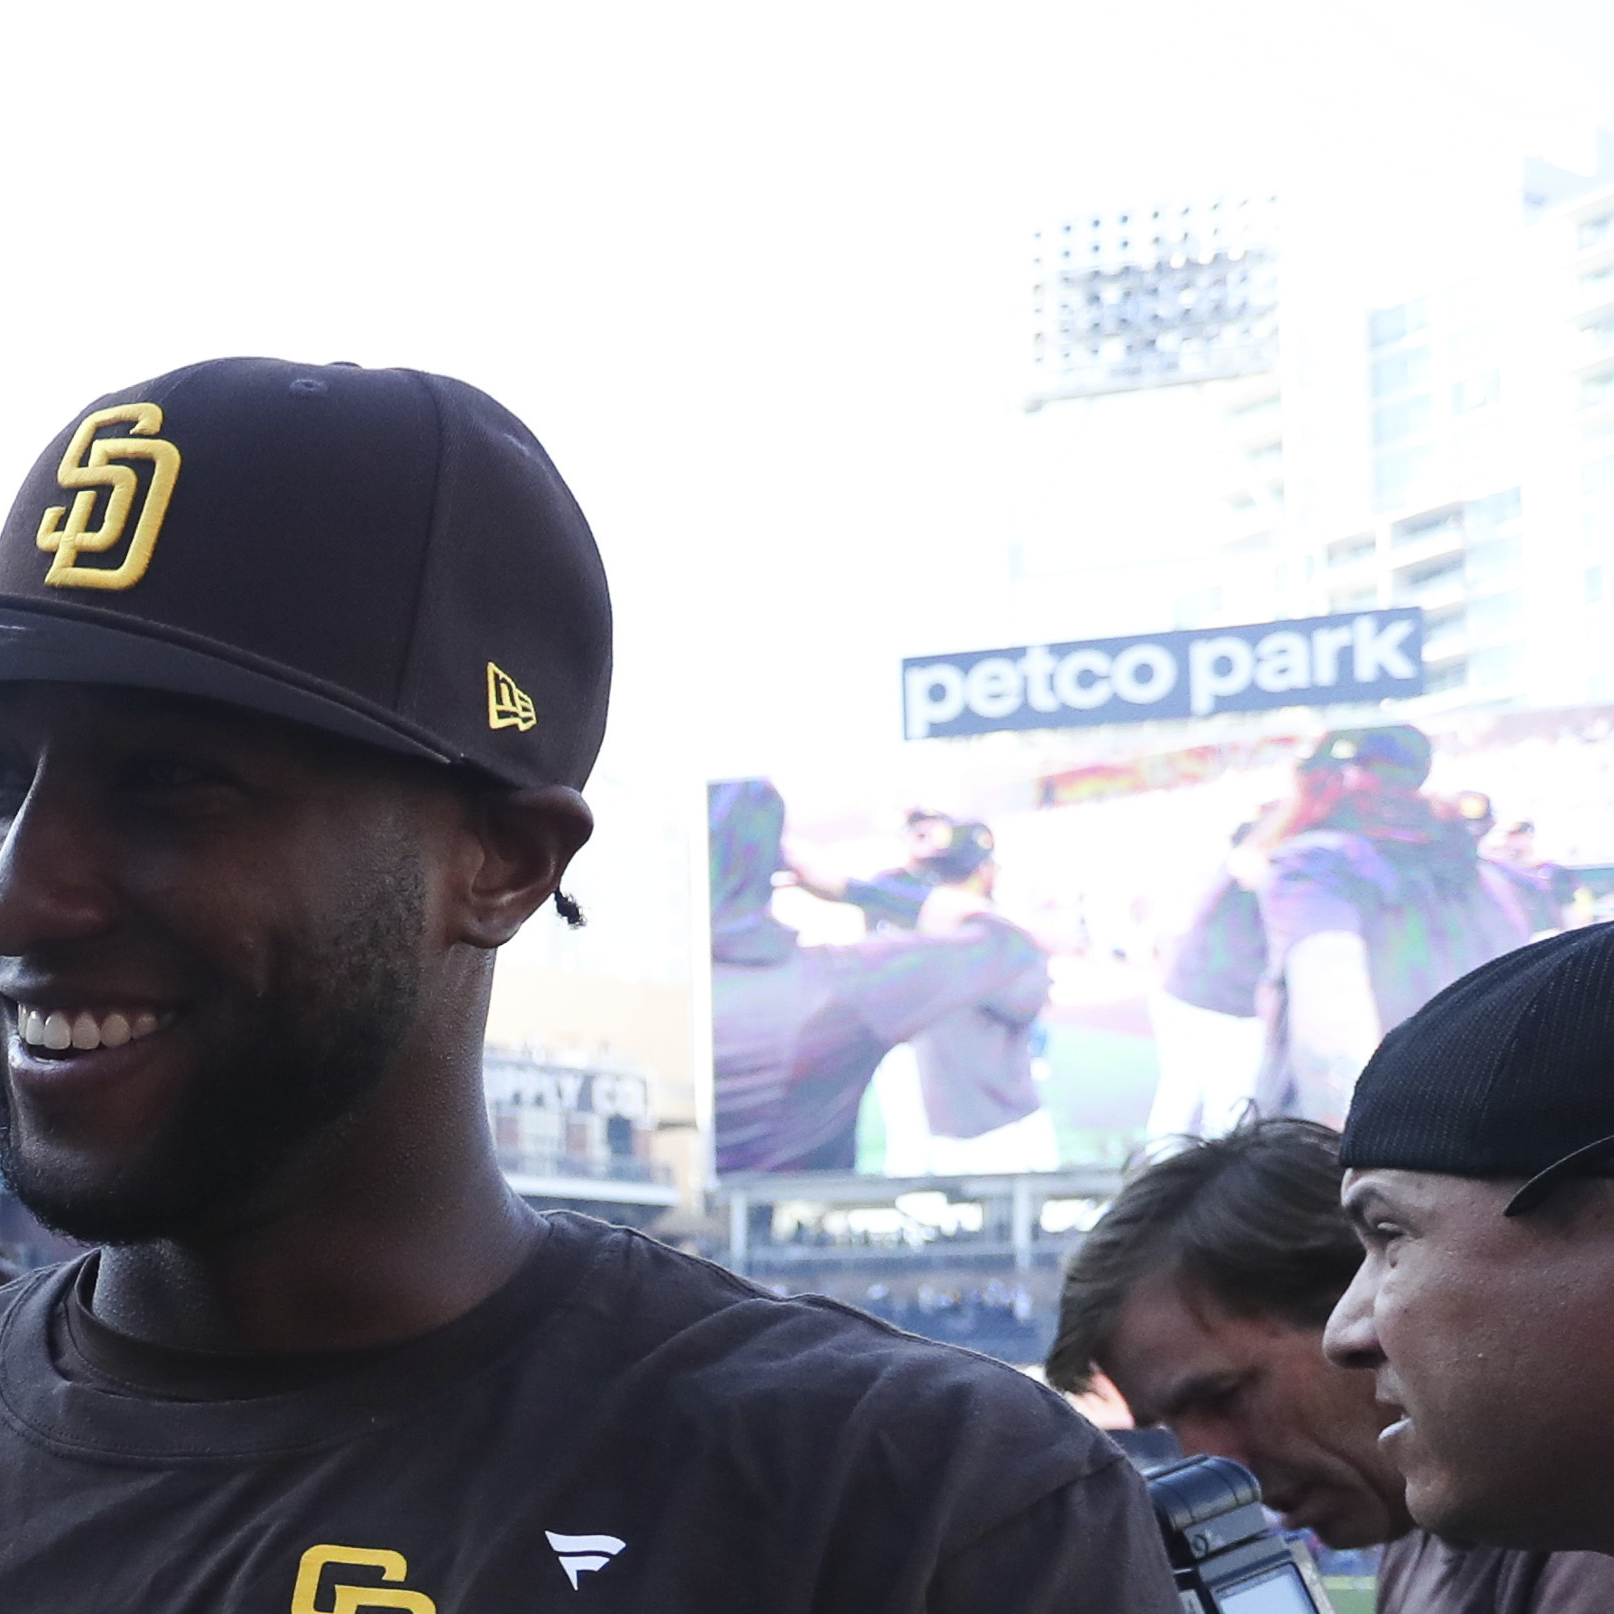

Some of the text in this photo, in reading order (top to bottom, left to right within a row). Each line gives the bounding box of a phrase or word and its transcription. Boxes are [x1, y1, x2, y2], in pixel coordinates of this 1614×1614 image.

[36, 402, 182, 590] SD
[903, 614, 1418, 738] petco park
